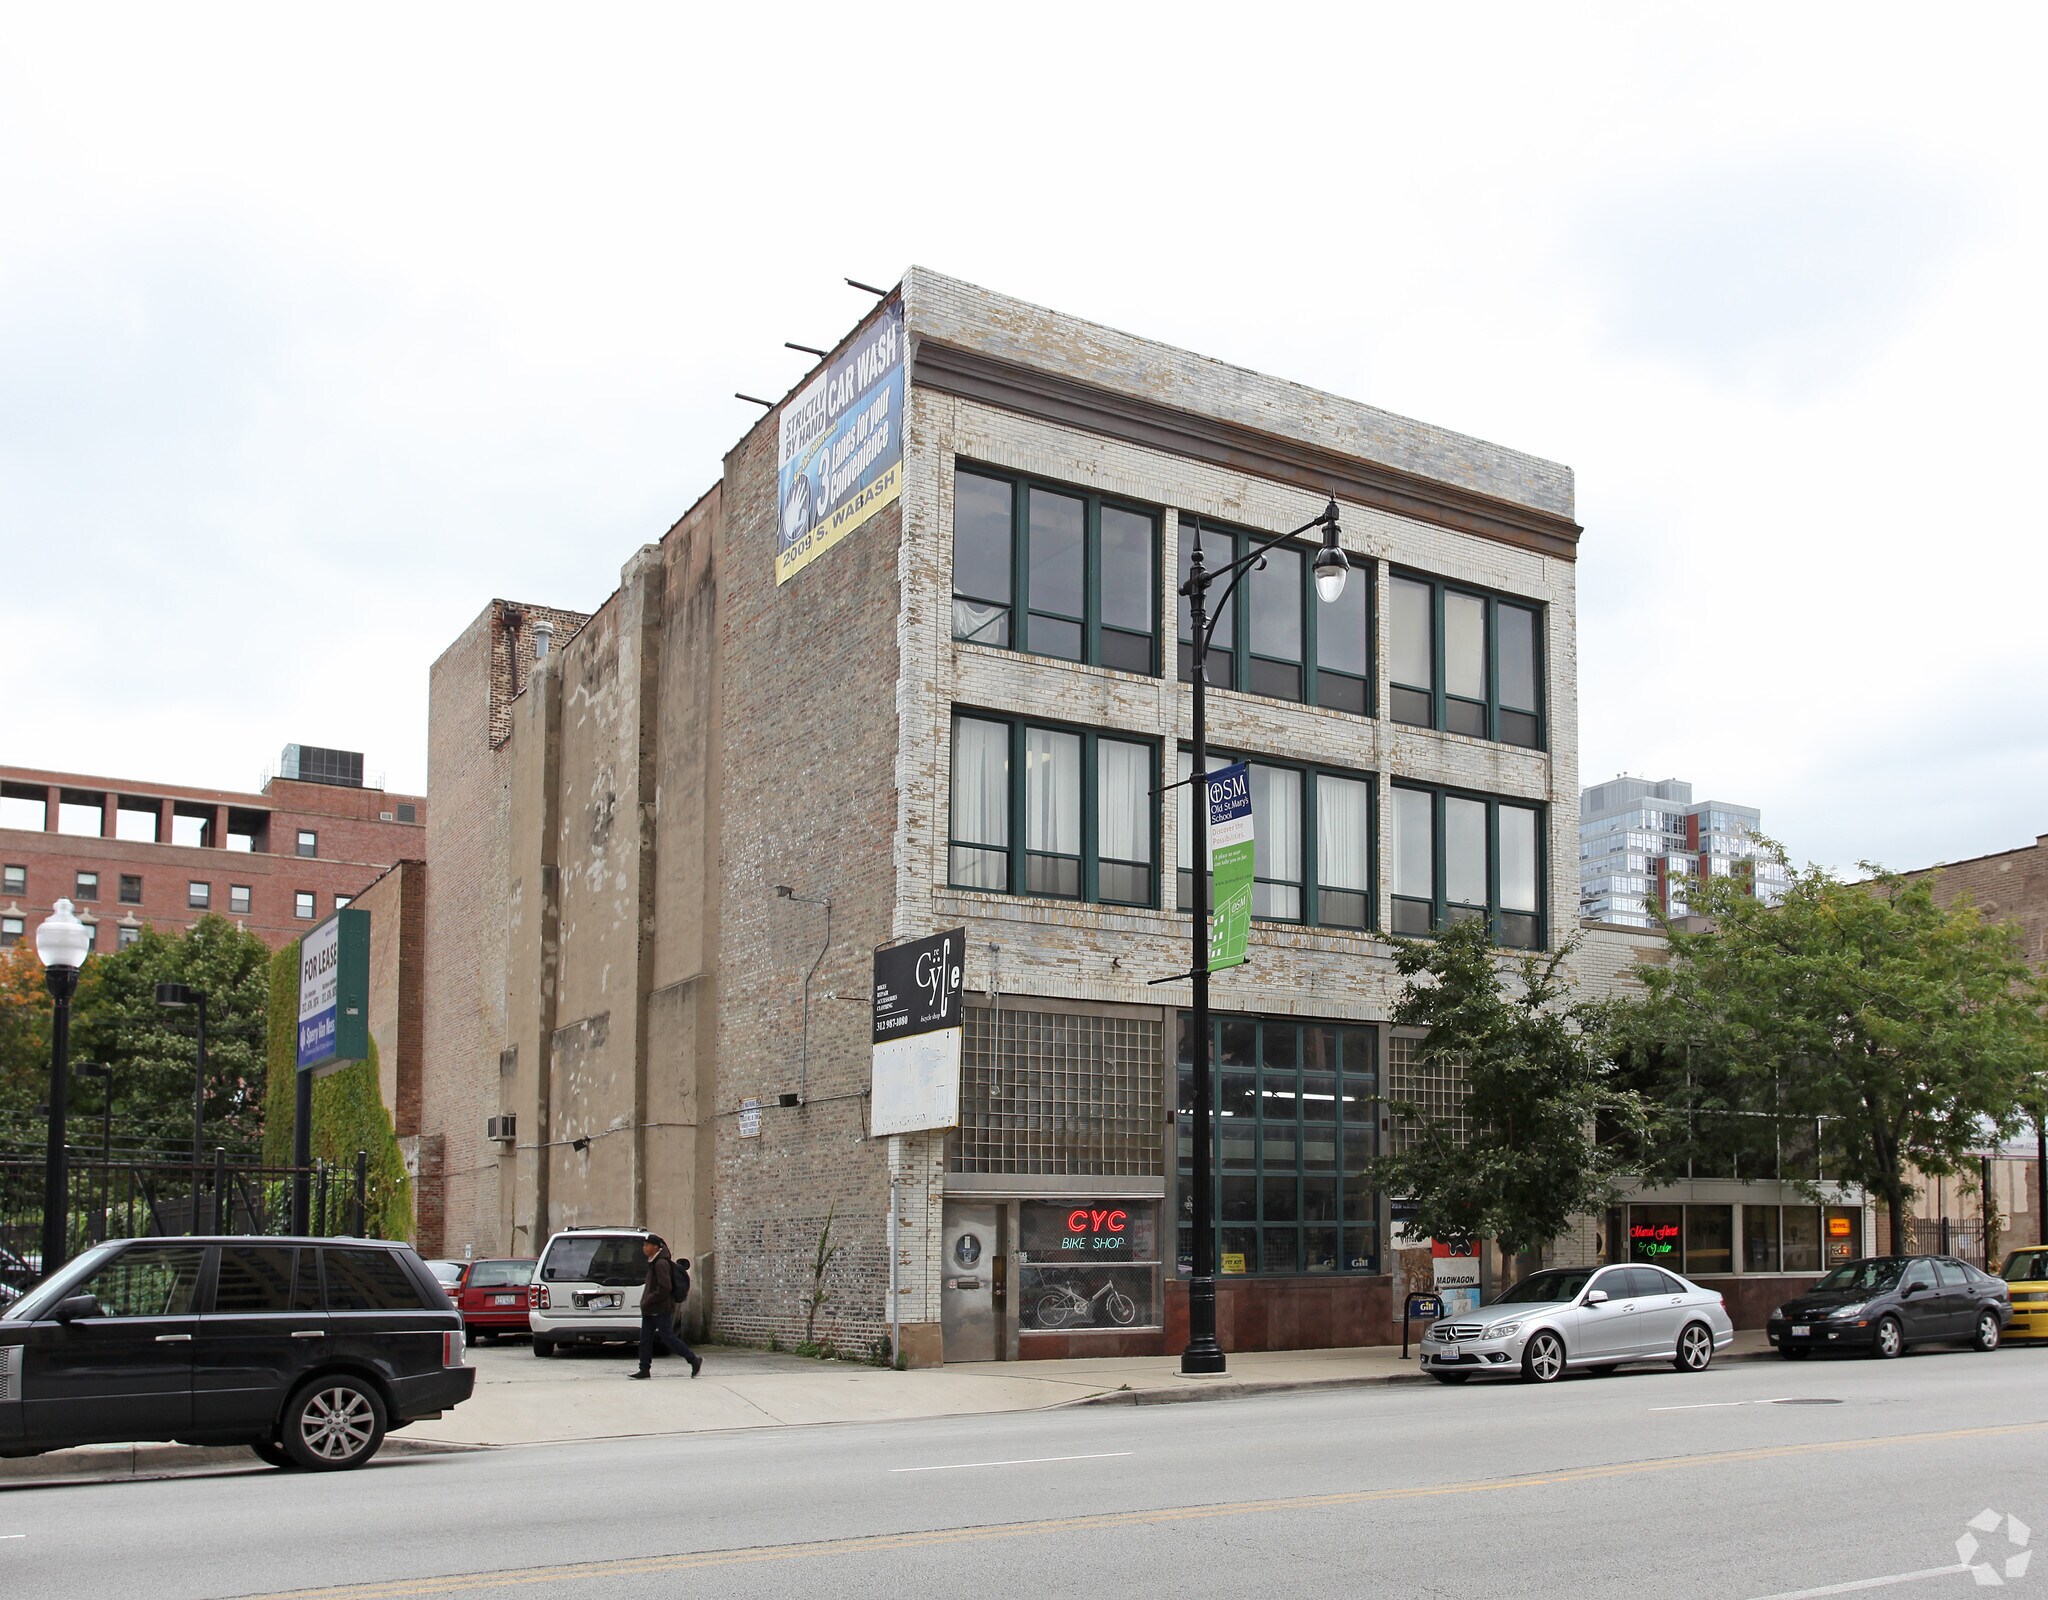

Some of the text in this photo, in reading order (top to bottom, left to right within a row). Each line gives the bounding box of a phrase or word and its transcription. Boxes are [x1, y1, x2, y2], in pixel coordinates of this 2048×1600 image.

[828, 323, 896, 417] CAR WASH
[786, 387, 826, 440] STRICTLY
[785, 411, 824, 461] BY HAND
[832, 385, 891, 473] Lanes for your
[816, 447, 830, 517] 3
[783, 470, 895, 568] 2009 S. WABASH
[1210, 774, 1247, 803] OSM
[1211, 804, 1223, 814] Old
[1211, 811, 1233, 823] School
[1212, 822, 1244, 836] Discover the
[304, 942, 337, 983] FOR LEASE
[931, 1012, 941, 1020] shop
[876, 1021, 886, 1031] 312
[1068, 1210, 1127, 1232] CYC
[1061, 1237, 1125, 1249] BIKE SHOP
[1351, 1257, 1368, 1267] Gill
[1437, 1276, 1474, 1284] MADWAGON
[1420, 1302, 1434, 1310] Gill
